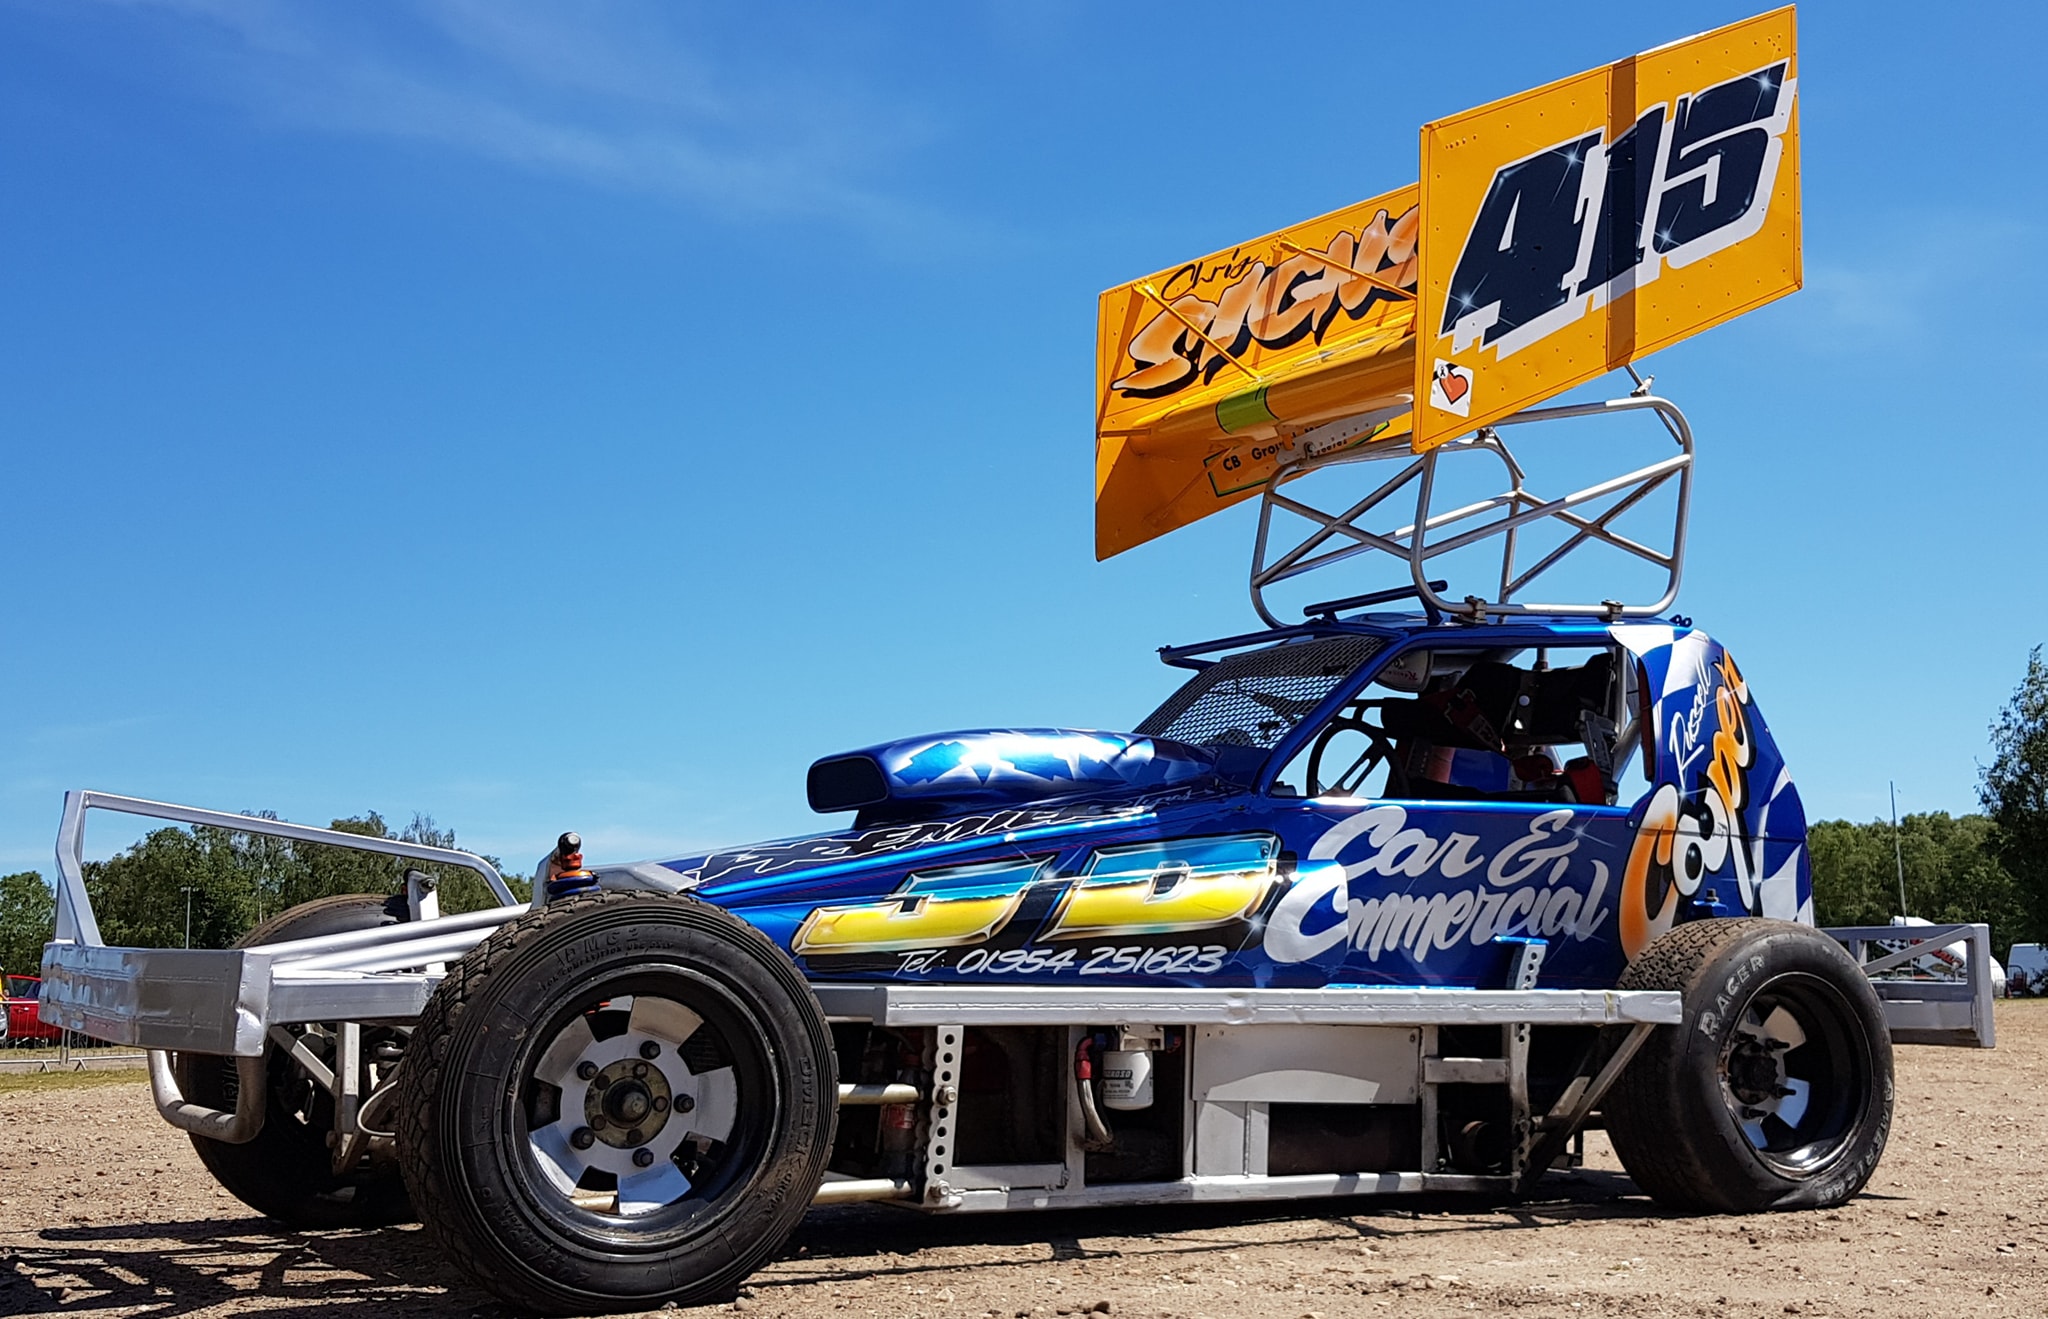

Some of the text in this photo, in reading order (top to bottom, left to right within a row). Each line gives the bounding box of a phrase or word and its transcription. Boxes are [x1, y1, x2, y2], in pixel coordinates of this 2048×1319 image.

[1438, 58, 1792, 355] 415
[1161, 247, 1261, 301] Chris
[1222, 454, 1241, 472] CB
[1669, 648, 1711, 786] Russell
[1308, 805, 1580, 887] Car &
[1263, 859, 1610, 963] Cmmercial
[956, 946, 1076, 976] 01954
[1080, 944, 1228, 976] 251623
[1699, 955, 1765, 1042] RACER
